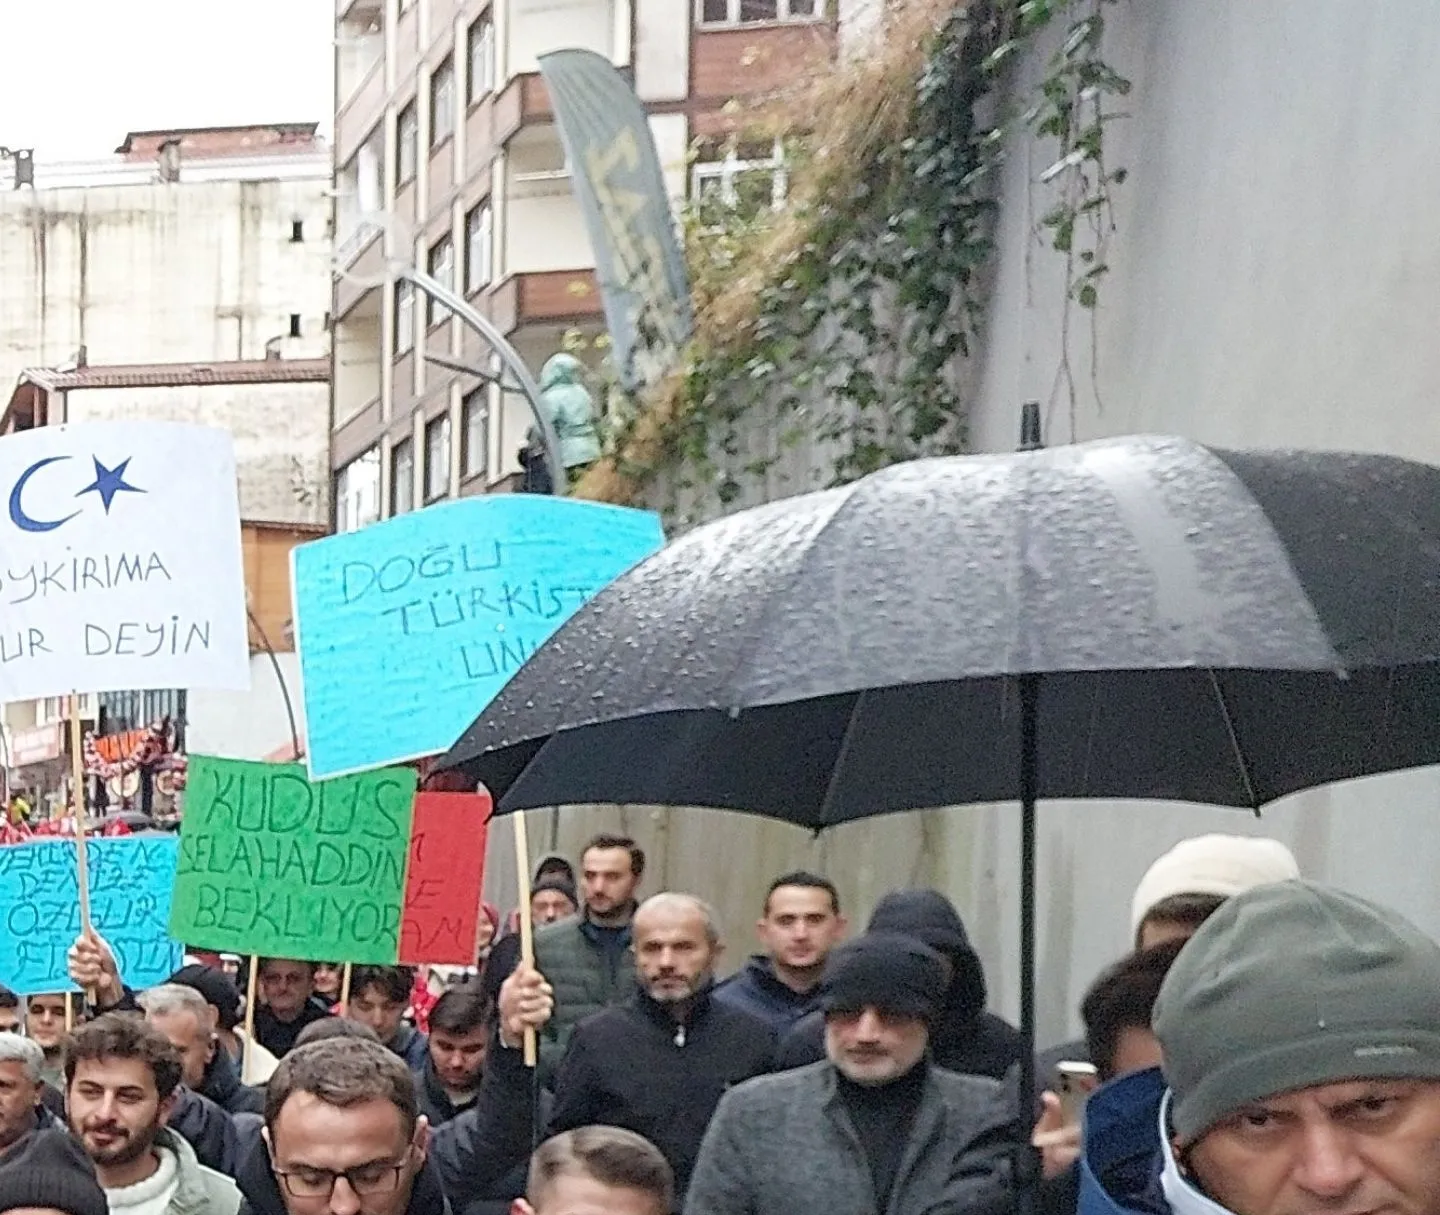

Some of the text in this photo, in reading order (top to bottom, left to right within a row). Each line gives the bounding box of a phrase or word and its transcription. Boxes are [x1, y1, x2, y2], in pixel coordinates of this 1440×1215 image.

[342, 540, 501, 604] DOĞU
[382, 579, 594, 635] TÜRKİST
[85, 614, 212, 658] DEYİN
